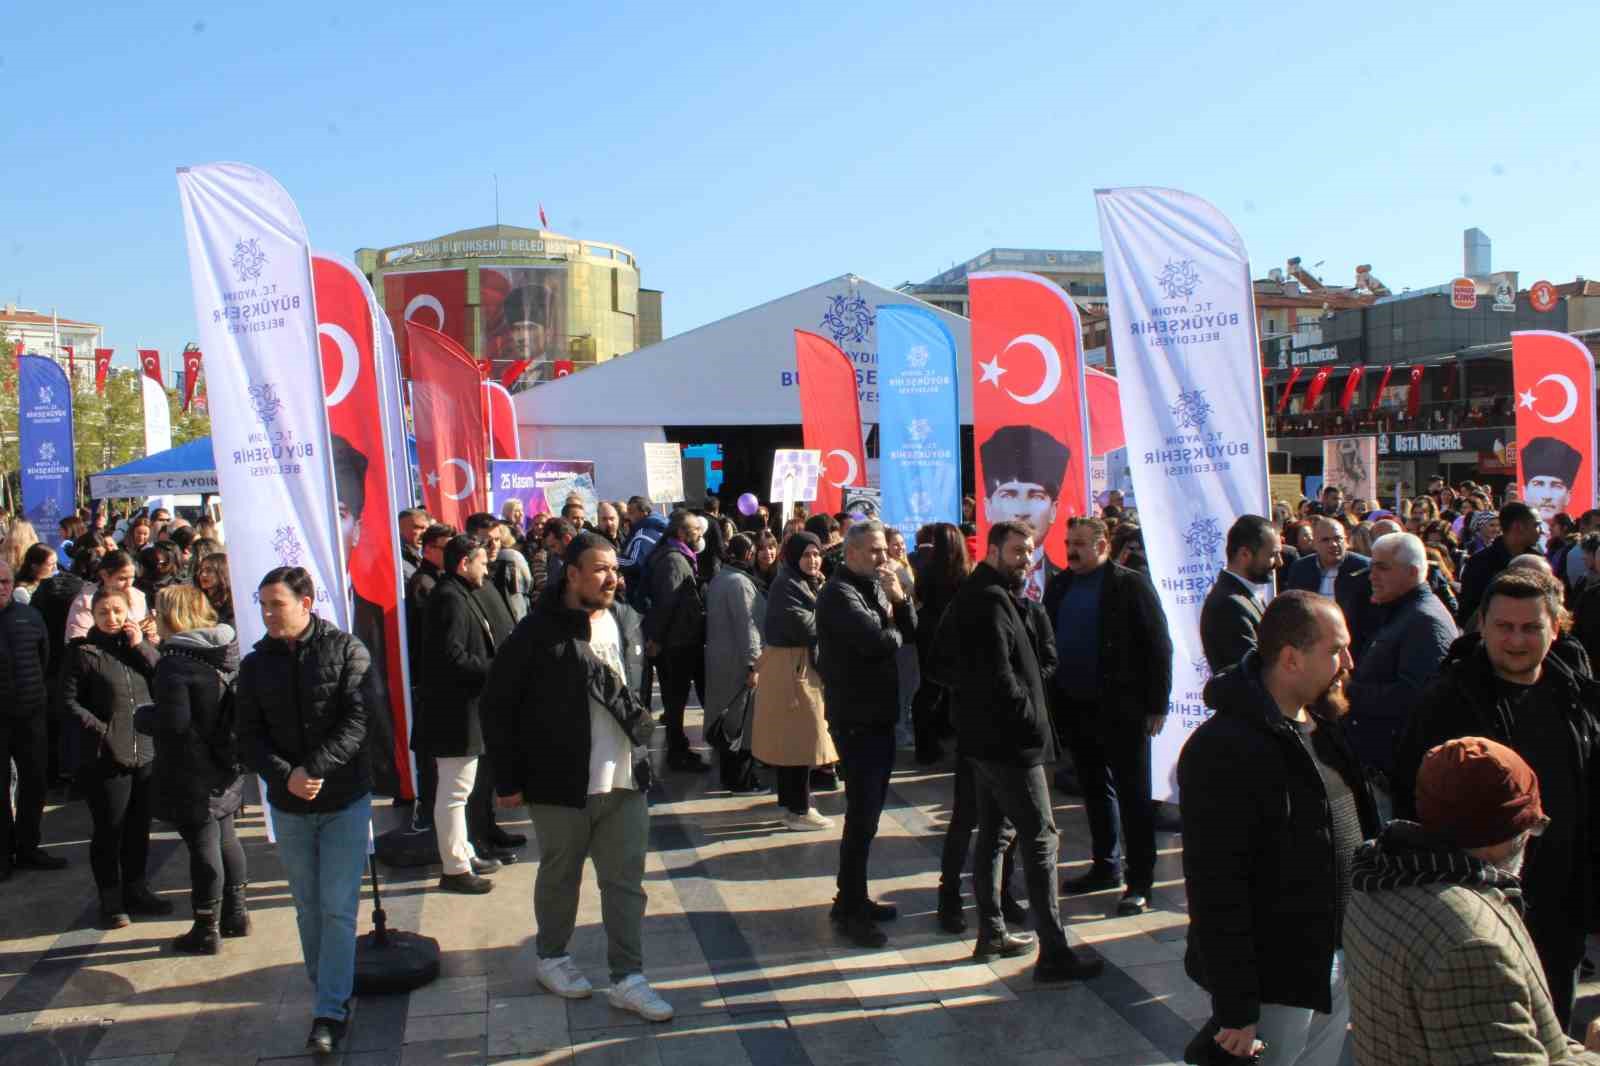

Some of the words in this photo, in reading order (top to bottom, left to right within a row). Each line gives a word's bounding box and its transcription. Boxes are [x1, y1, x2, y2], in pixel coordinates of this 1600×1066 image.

[1395, 434, 1419, 452] USTA
[157, 479, 178, 489] T.C.
[182, 476, 218, 488] AYDIN
[501, 472, 511, 488] 25
